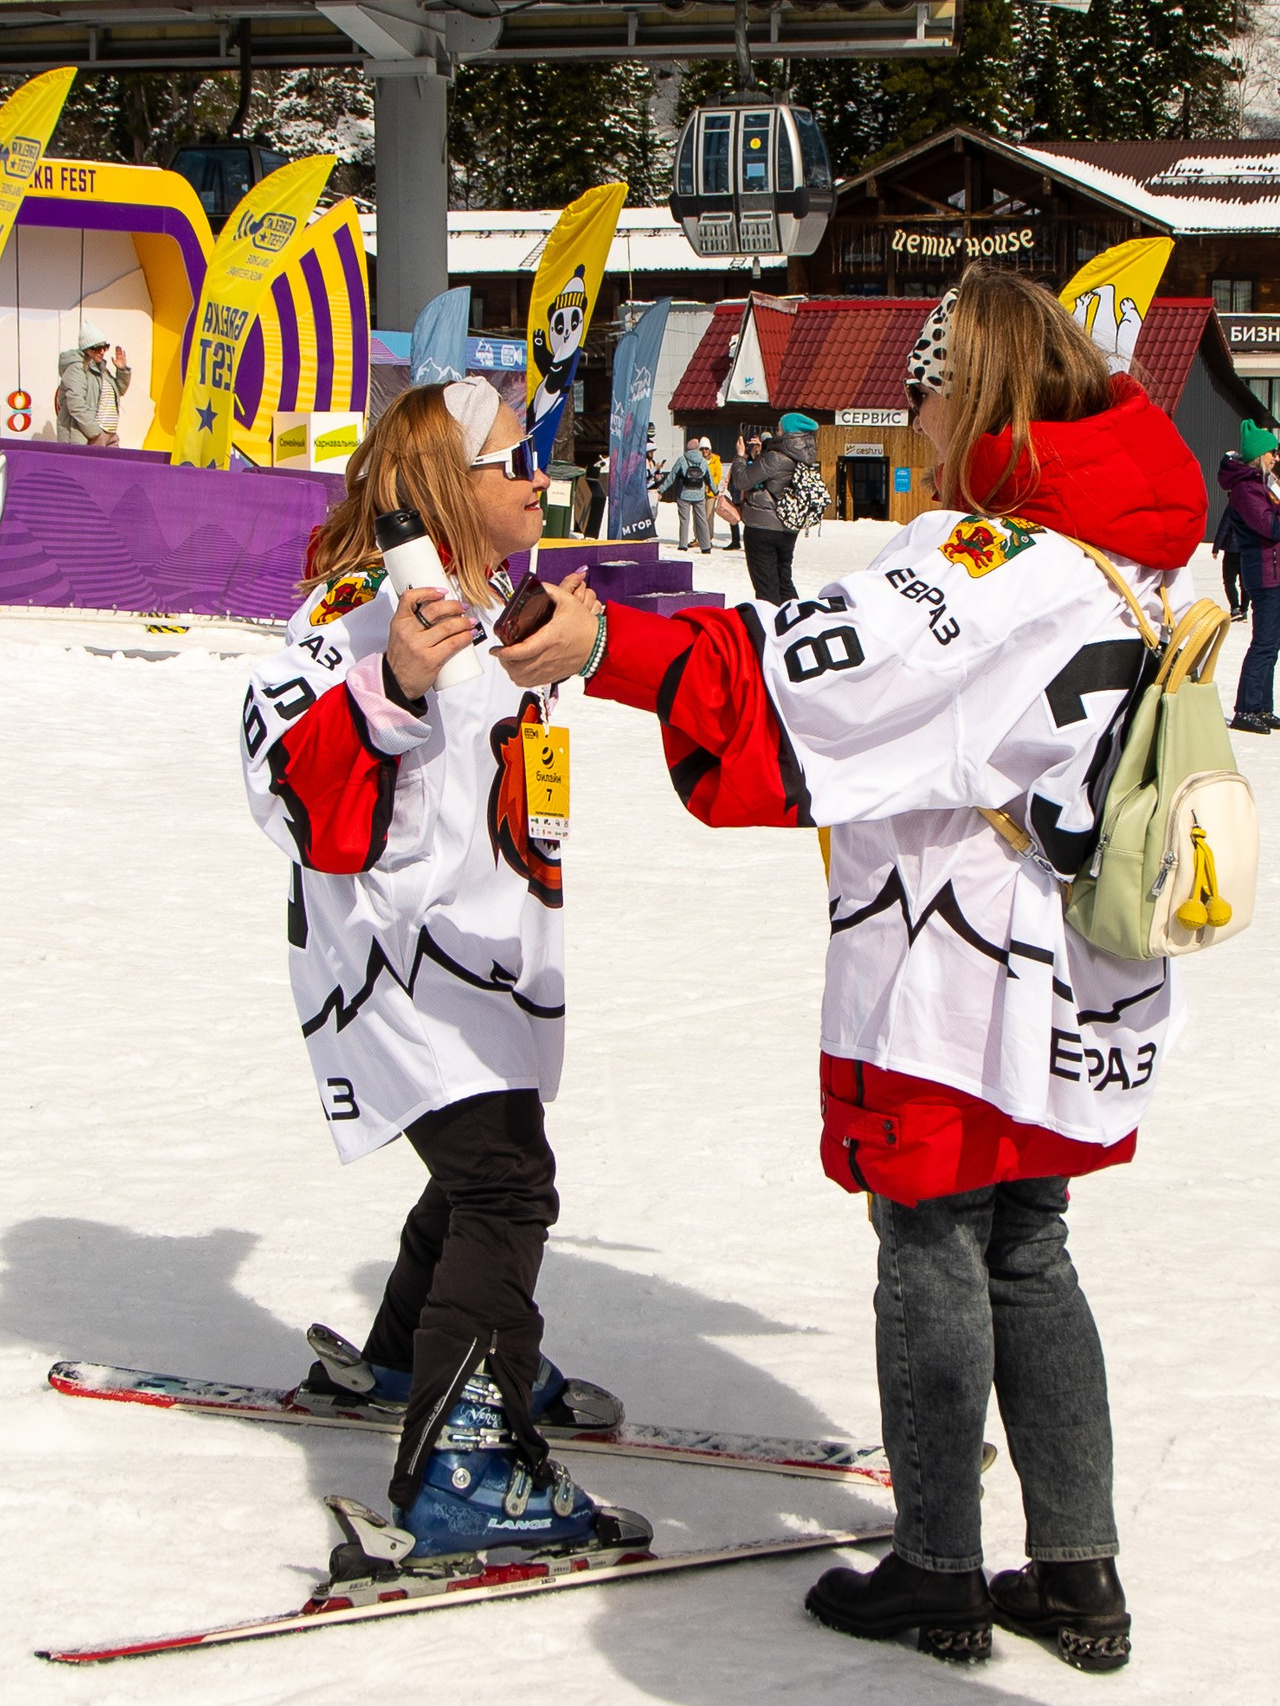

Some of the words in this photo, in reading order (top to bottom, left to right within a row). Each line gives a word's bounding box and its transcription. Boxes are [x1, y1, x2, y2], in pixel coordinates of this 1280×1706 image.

[29, 165, 53, 190] KA
[60, 167, 97, 193] FEST
[1230, 326, 1280, 342] БИЗН
[841, 411, 902, 425] СЕРВИС
[884, 567, 962, 646] ЕВРАЗ
[298, 633, 343, 672] АЗ
[535, 770, 562, 784] билайн
[546, 788, 553, 802] 7
[1049, 1026, 1157, 1092] ЕРАЗ
[487, 1517, 553, 1530] LANGE
